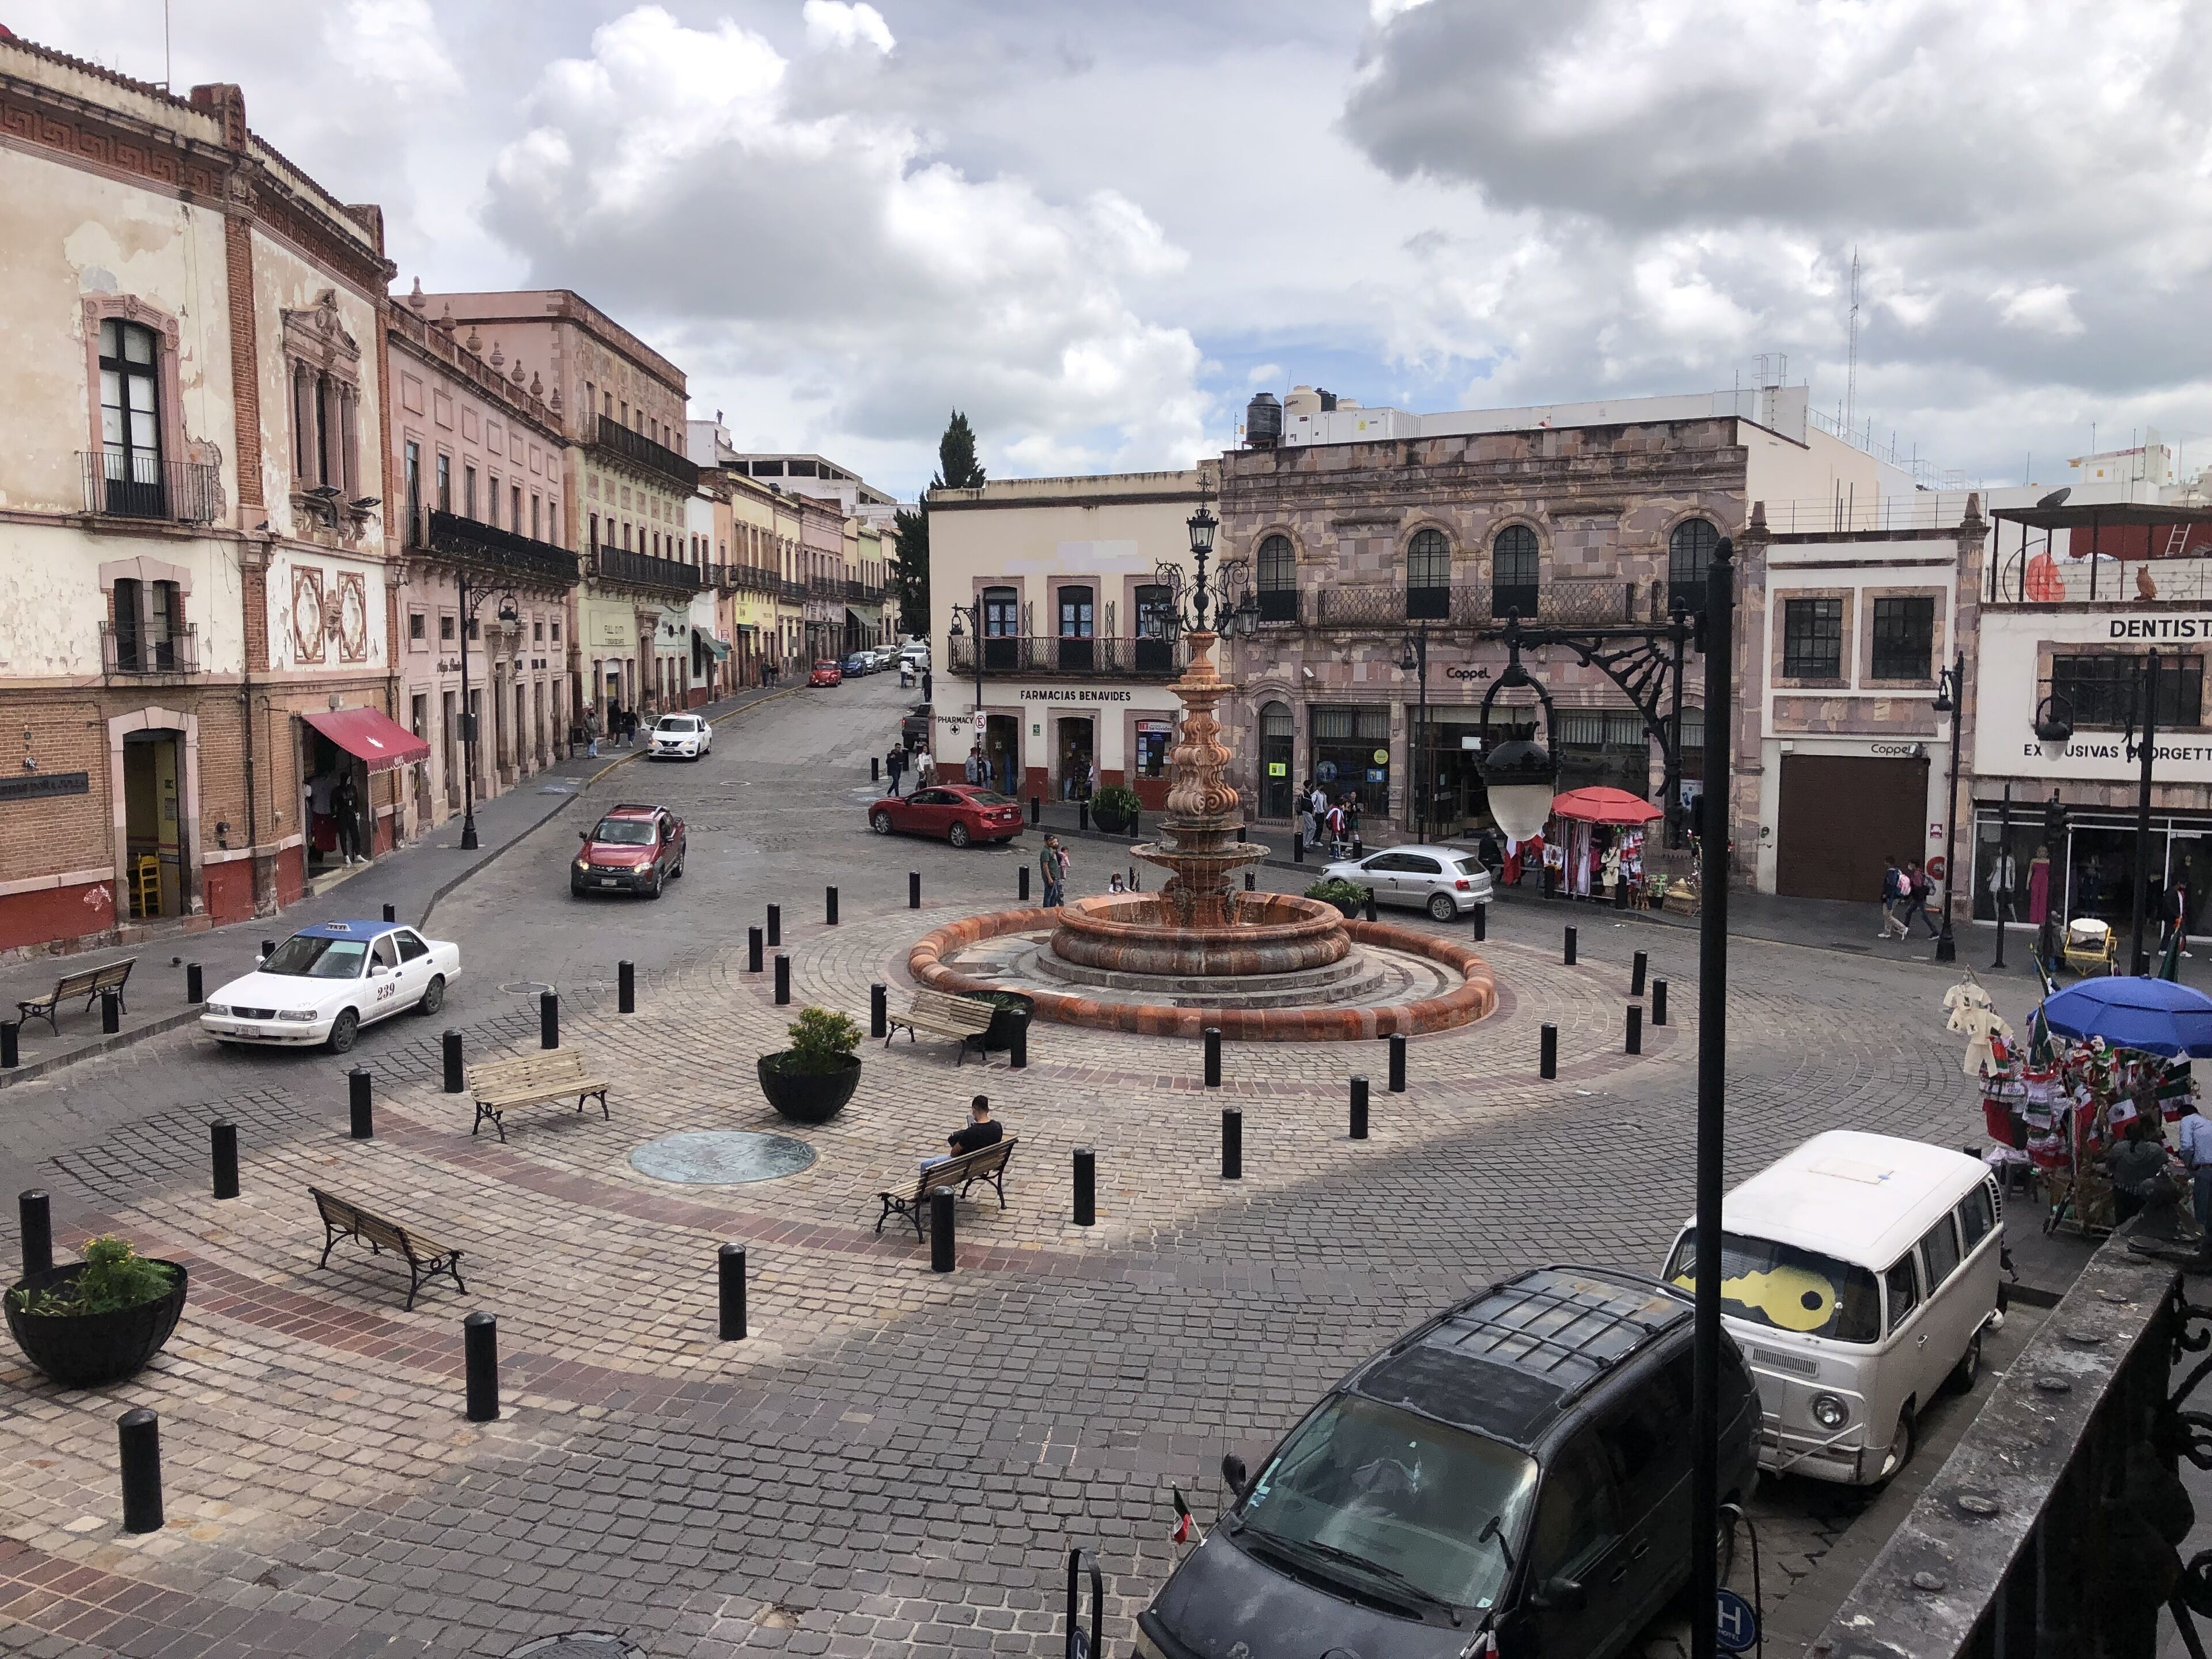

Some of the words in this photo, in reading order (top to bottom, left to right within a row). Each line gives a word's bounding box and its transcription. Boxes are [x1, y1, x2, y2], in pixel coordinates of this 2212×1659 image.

[2110, 619, 2212, 638] DENTIST
[1446, 667, 1491, 681] Coppel
[1020, 690, 1075, 700] FARMACIAS
[1079, 691, 1131, 701] BENAVIDES
[2024, 744, 2119, 758] EXUSIVAS
[377, 982, 395, 1001] 239
[1718, 1600, 1741, 1635] H
